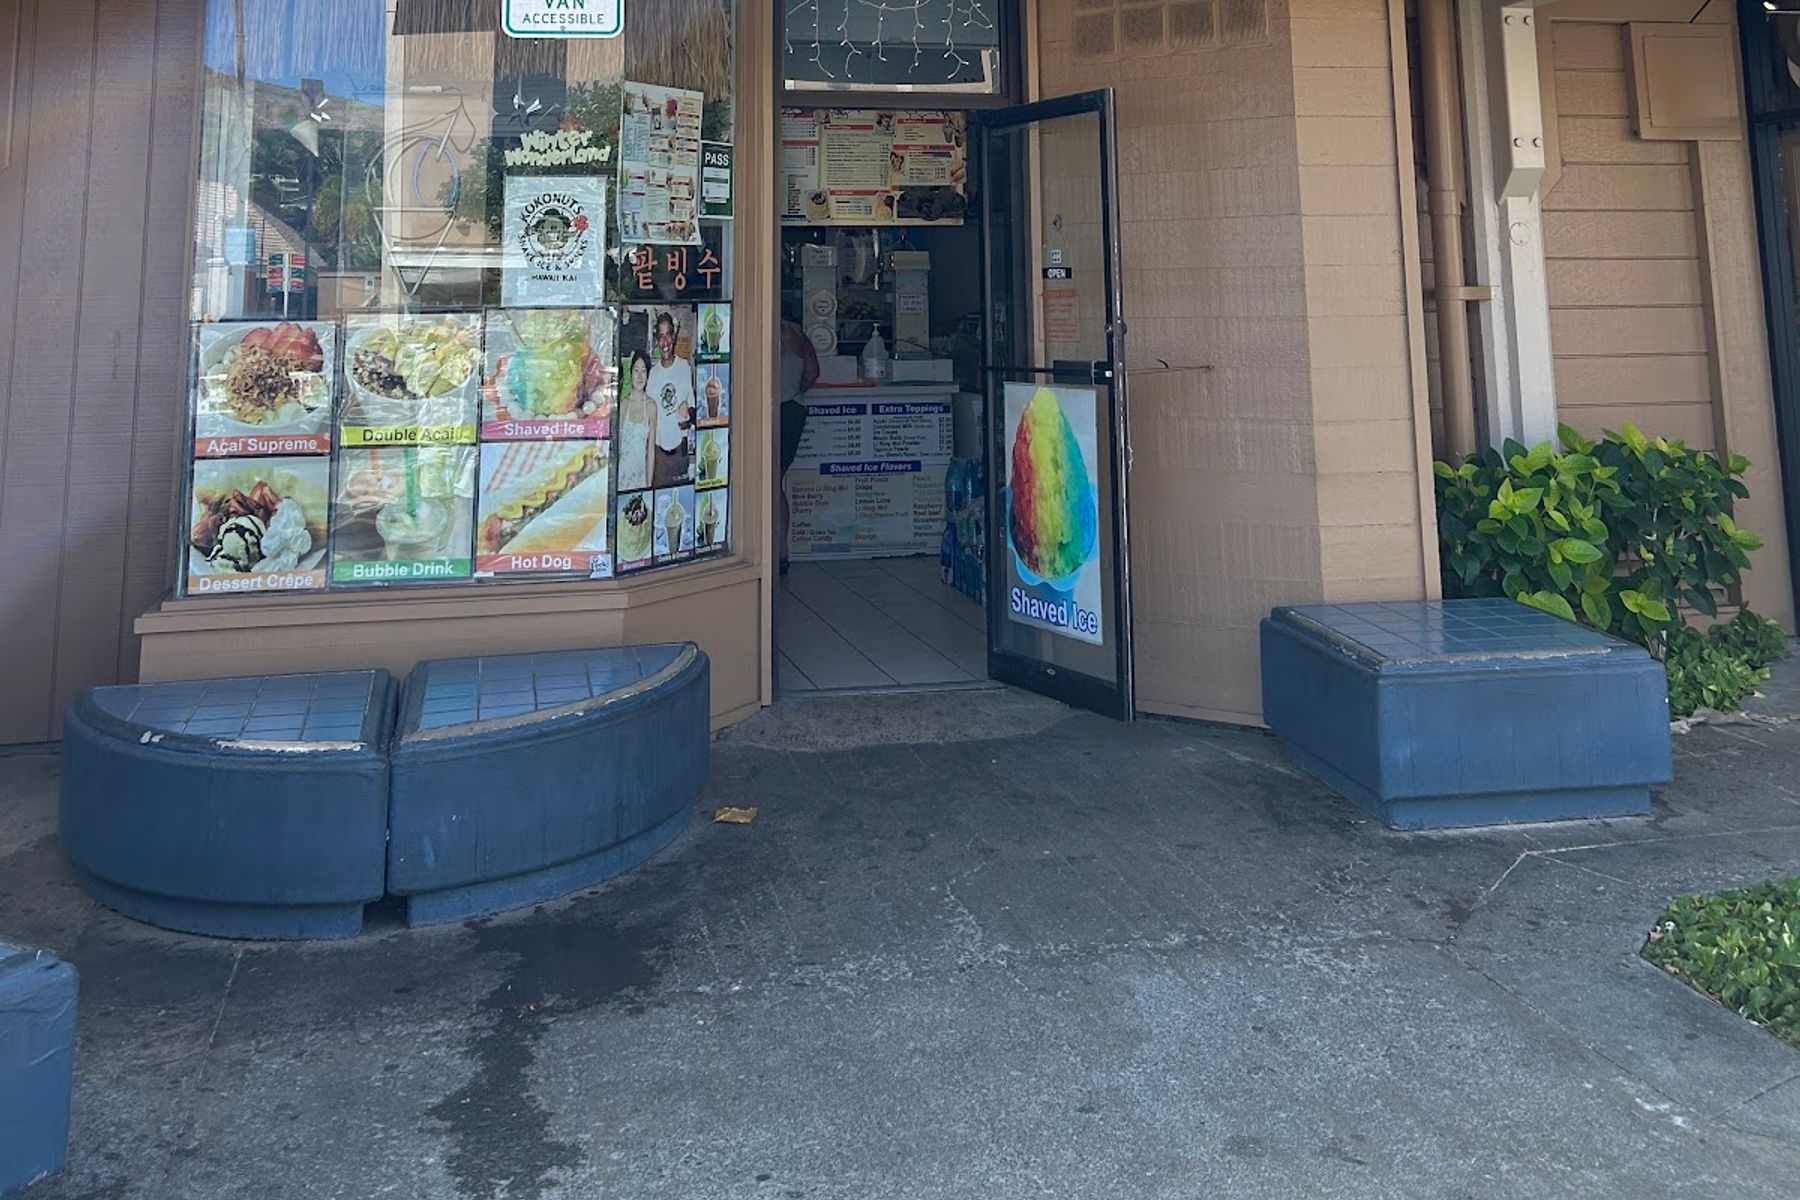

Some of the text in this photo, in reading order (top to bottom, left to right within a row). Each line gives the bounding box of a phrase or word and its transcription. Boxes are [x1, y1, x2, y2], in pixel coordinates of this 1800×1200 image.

[522, 13, 605, 25] ACCESSIBLE
[705, 152, 730, 167] PASS
[519, 192, 585, 226] KOKONUTS
[562, 274, 578, 282] KAI
[1047, 268, 1066, 279] OPEN
[842, 406, 857, 414] Ice
[879, 405, 902, 413] Extra
[362, 427, 455, 442] Double Acai
[504, 422, 585, 436] Shaved Ice
[247, 437, 317, 456] Supreme
[864, 464, 877, 472] Ice
[353, 560, 454, 578] Bubble Drink
[511, 555, 537, 569] Hot
[541, 555, 572, 570] Dog
[199, 574, 262, 591] Dessert
[1011, 585, 1099, 634] Shaved Ice
